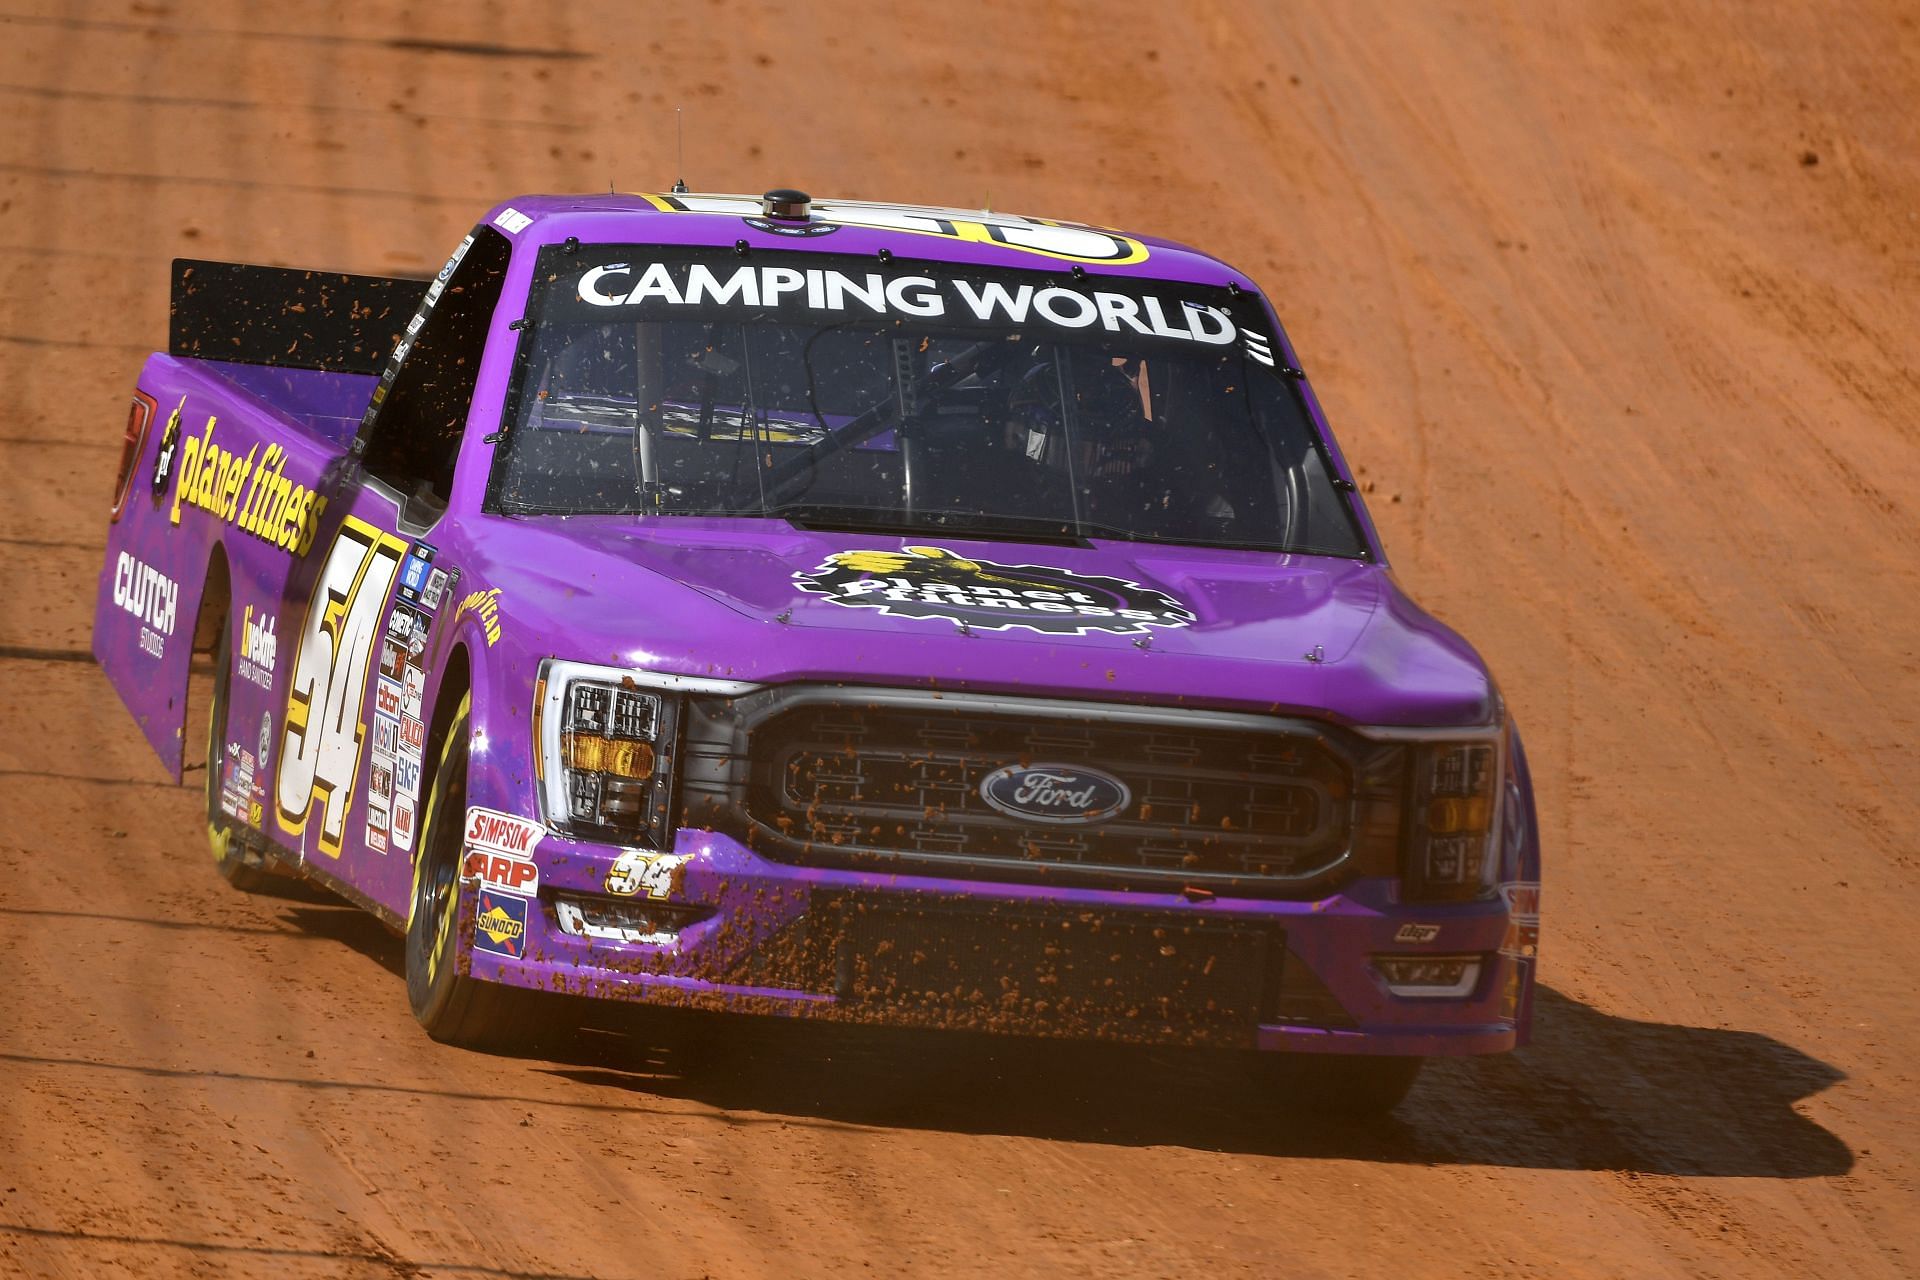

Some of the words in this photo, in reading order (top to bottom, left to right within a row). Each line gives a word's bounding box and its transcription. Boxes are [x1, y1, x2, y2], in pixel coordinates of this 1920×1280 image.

[577, 262, 944, 318] CAMPING
[952, 278, 1238, 346] WORLD
[170, 416, 259, 525] planet
[237, 441, 329, 558] fitness
[113, 551, 179, 636] CLUTCH
[837, 576, 1094, 605] planet
[880, 587, 1159, 622] fitness
[388, 609, 414, 637] COMETIC
[454, 588, 503, 648] GOODYEAR
[139, 626, 165, 659] STUDIOS
[276, 514, 409, 860] 54
[375, 716, 392, 751] Mobil
[400, 716, 424, 749] CALICO
[397, 756, 420, 793] SKF
[1013, 772, 1097, 809] Ford
[369, 809, 387, 831] LINCOLN
[468, 813, 536, 852] SIMPSON
[463, 854, 537, 887] ARP
[605, 850, 695, 901] 54
[478, 915, 521, 938] SUNOCO
